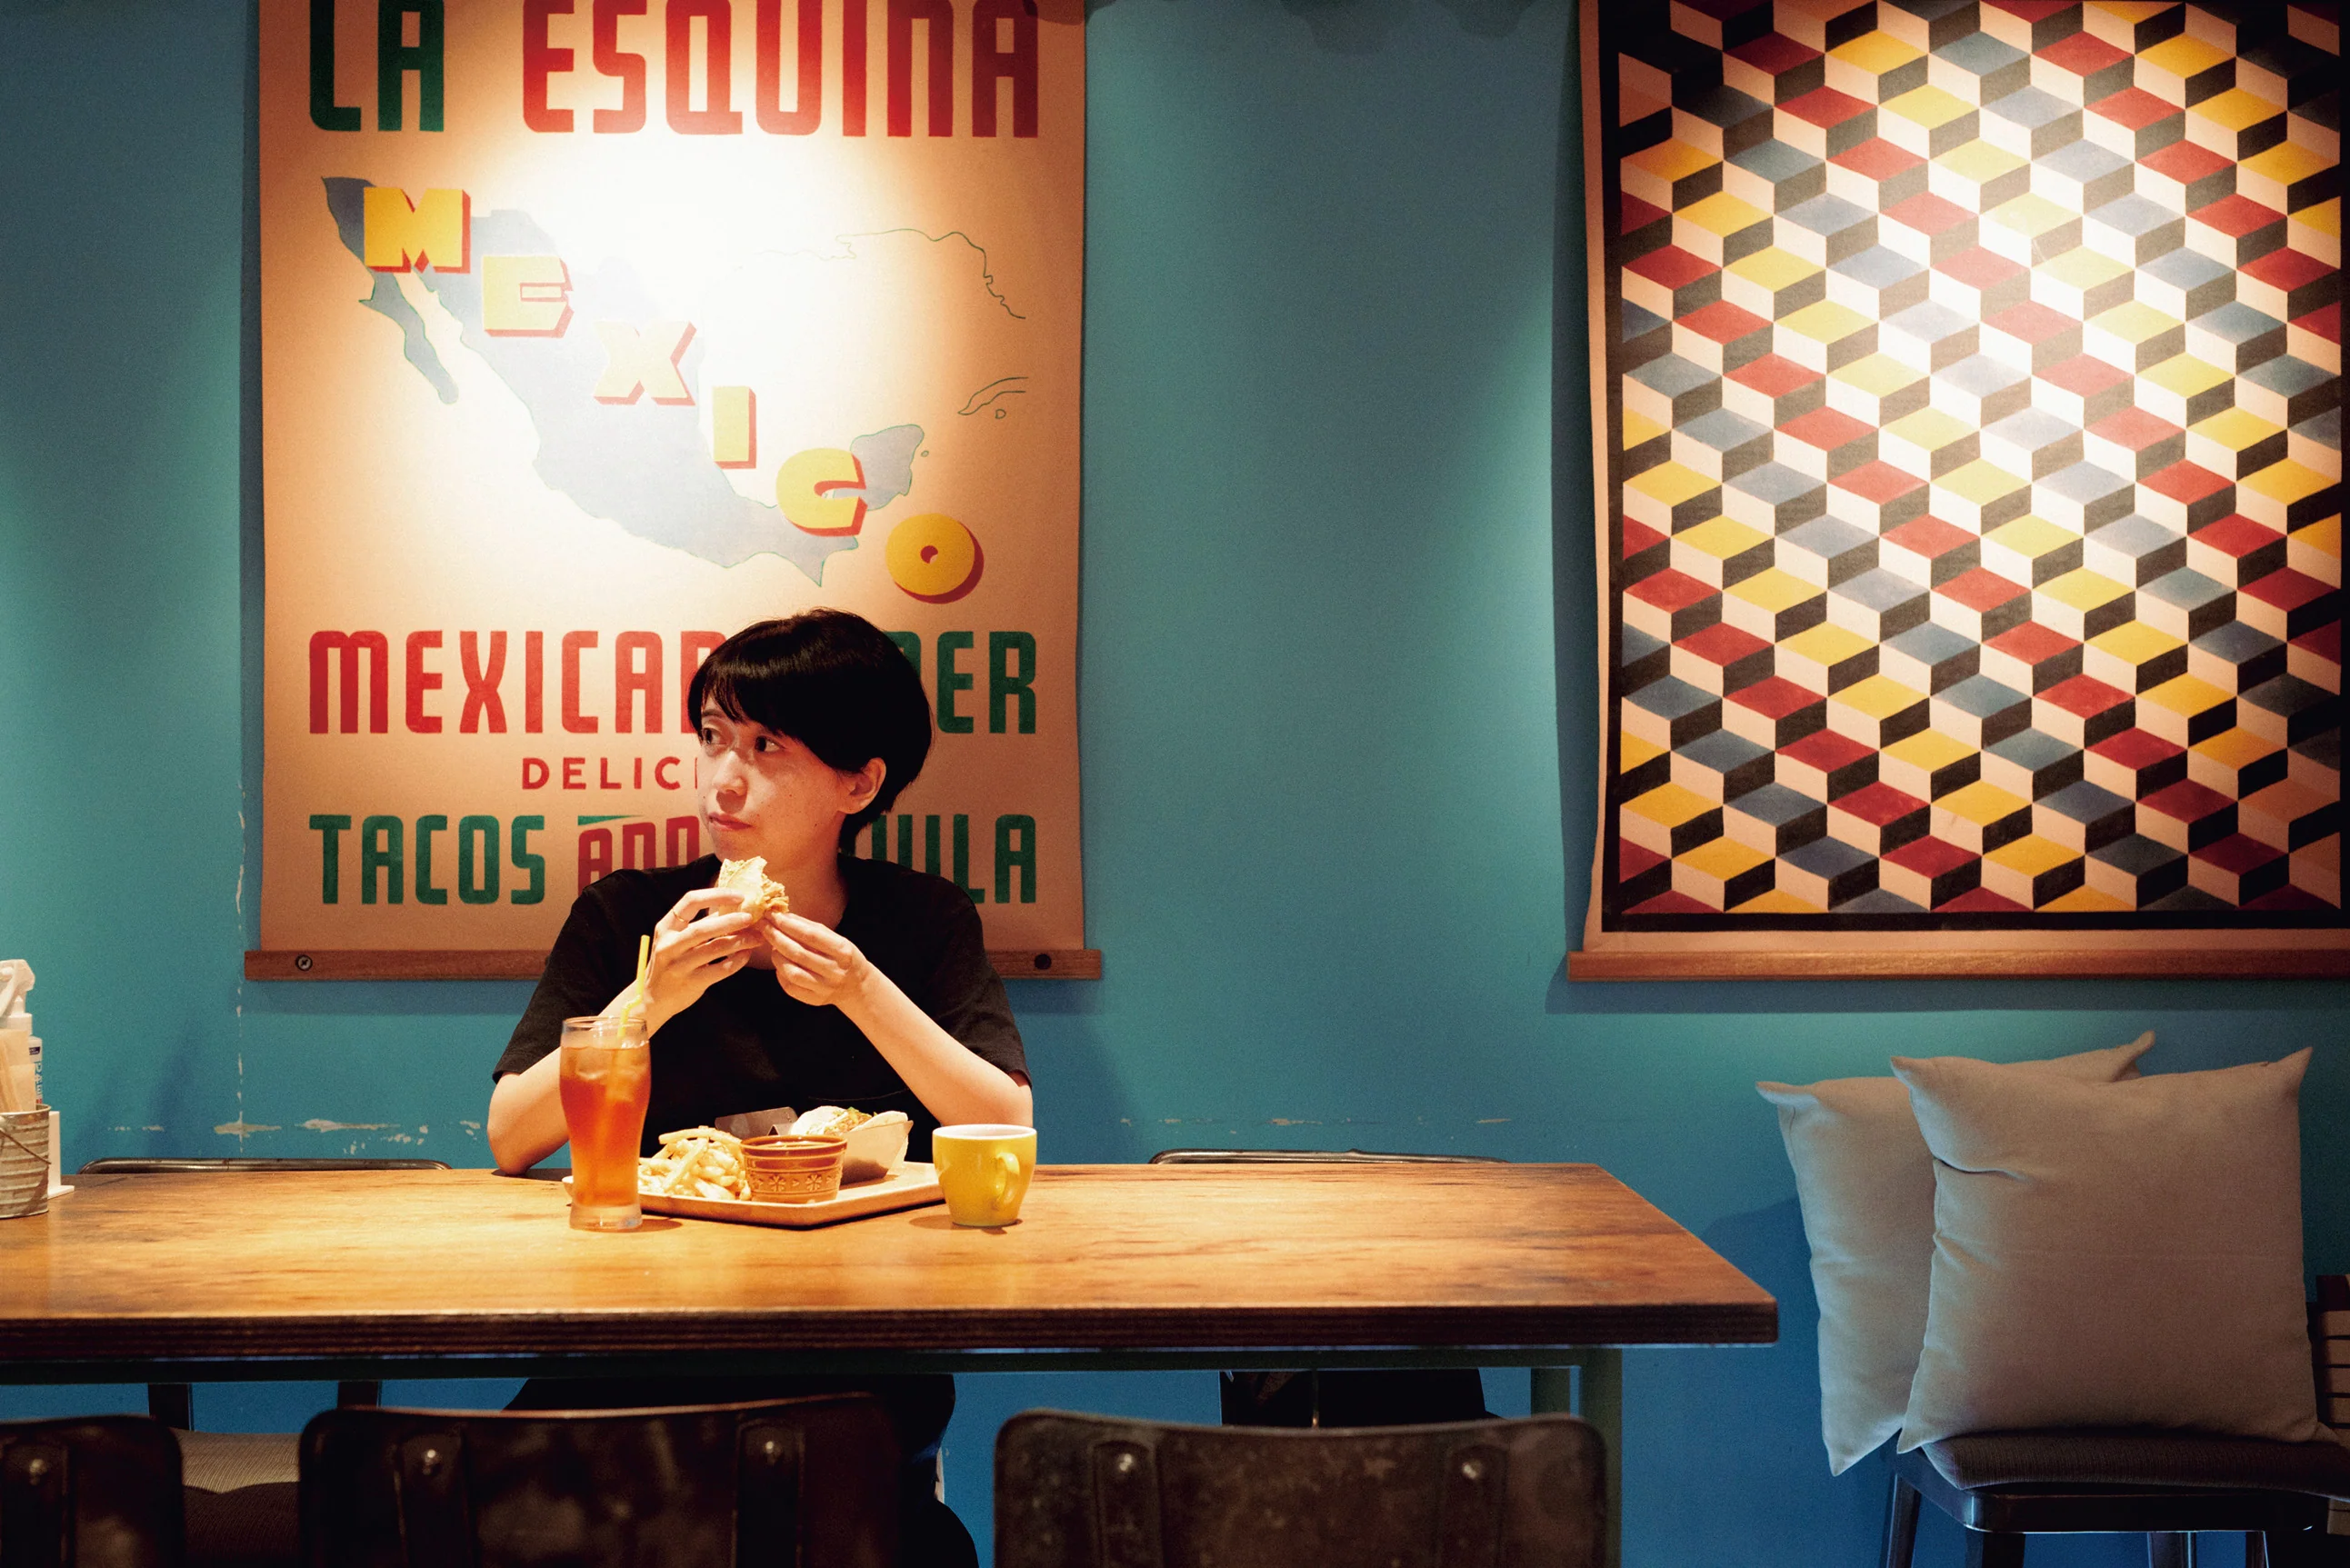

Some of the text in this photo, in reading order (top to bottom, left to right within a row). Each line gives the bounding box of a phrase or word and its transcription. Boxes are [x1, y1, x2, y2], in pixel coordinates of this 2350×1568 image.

[309, 0, 1038, 138] LA ESQUINA
[364, 185, 984, 604] MEXICO
[522, 756, 698, 790] DELIC
[309, 814, 545, 904] TACOS
